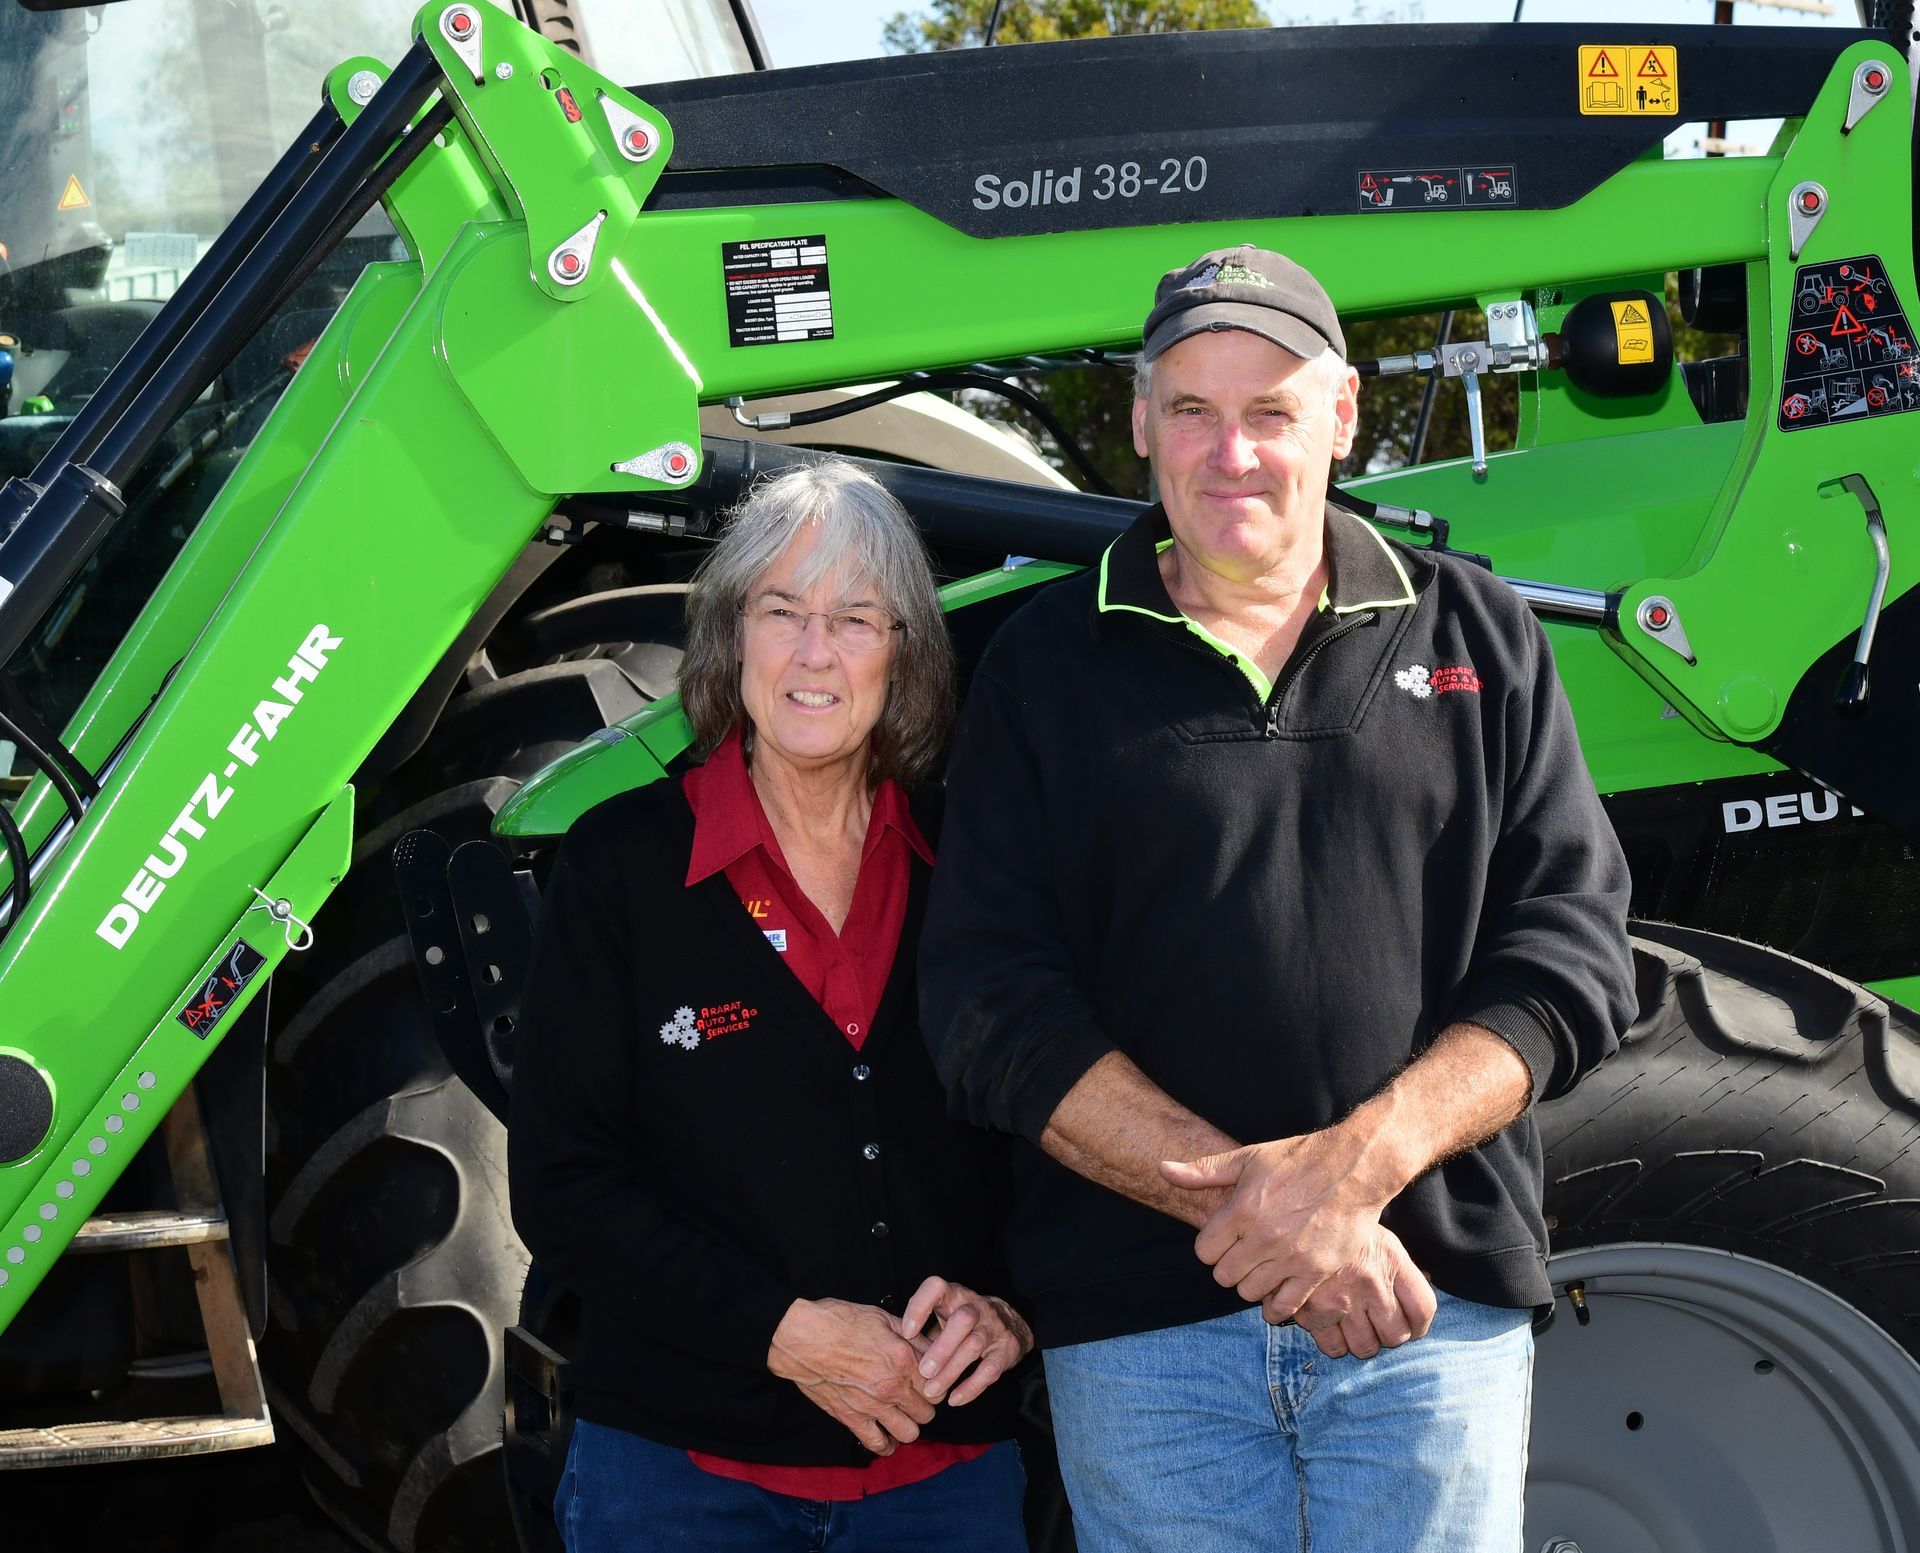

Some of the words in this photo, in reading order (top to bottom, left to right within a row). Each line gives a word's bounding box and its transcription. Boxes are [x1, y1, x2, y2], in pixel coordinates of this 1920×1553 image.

[972, 167, 1082, 210] Solid
[1093, 156, 1207, 200] 38-20
[751, 241, 790, 250] SPECIFICATION
[1430, 676, 1458, 686] AUTO
[1438, 683, 1479, 693] SERVICES
[95, 623, 344, 950] DEUTZ-FAHR
[1722, 790, 1865, 833] DEU
[696, 1016, 726, 1030] AUTO
[742, 1008, 758, 1019] AG
[701, 1001, 741, 1018] ARARAT
[706, 1021, 750, 1040] SERVICES
